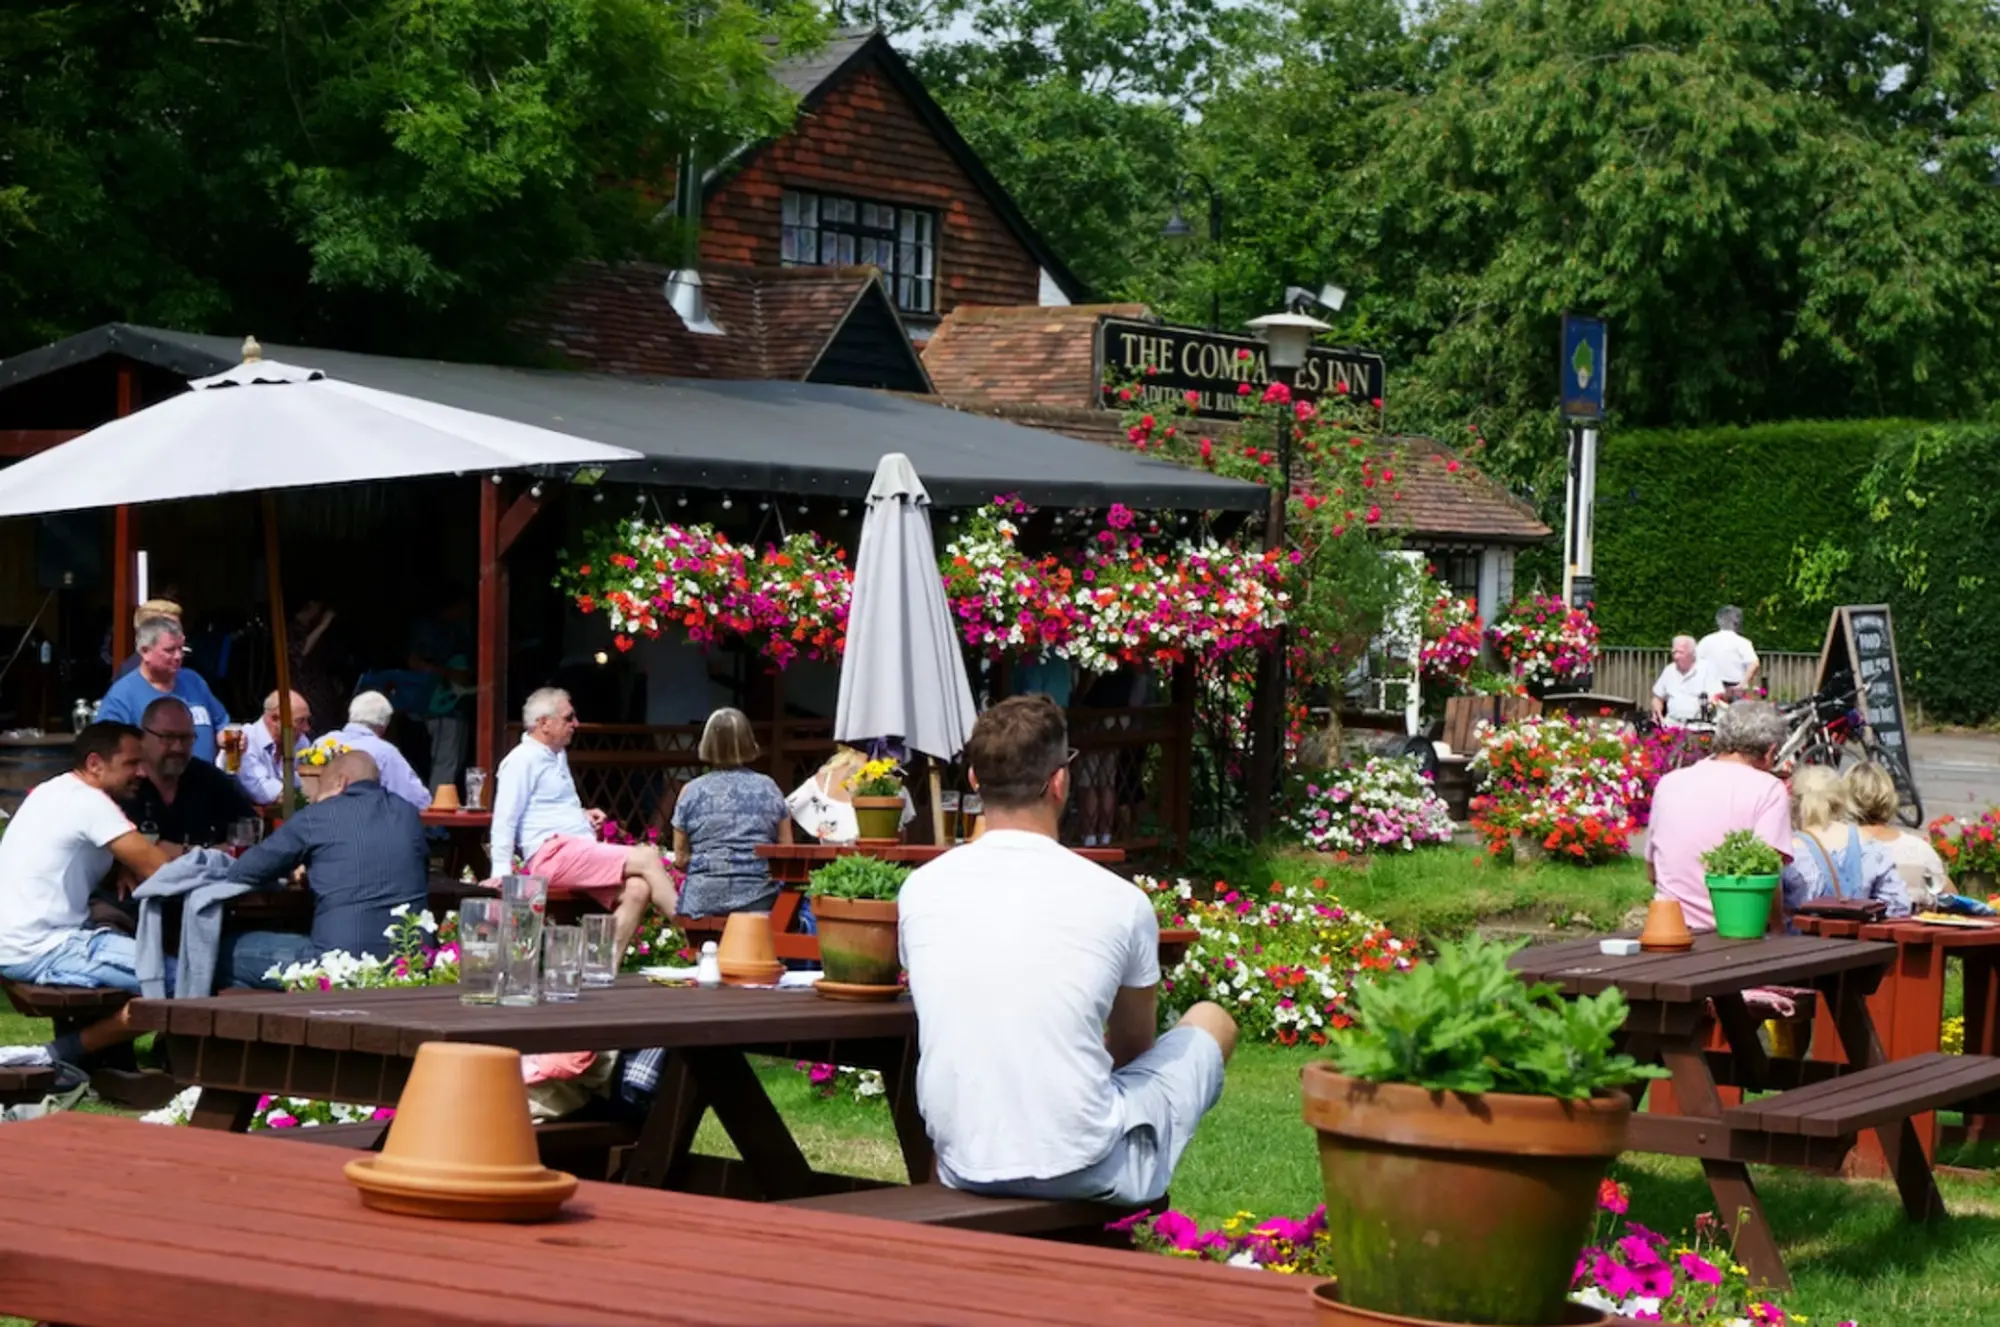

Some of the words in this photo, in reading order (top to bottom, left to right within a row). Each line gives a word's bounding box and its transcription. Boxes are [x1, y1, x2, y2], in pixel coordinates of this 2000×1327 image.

[1120, 333, 1174, 374] THE
[1181, 341, 1320, 392] COMPAES
[1327, 359, 1370, 396] INN
